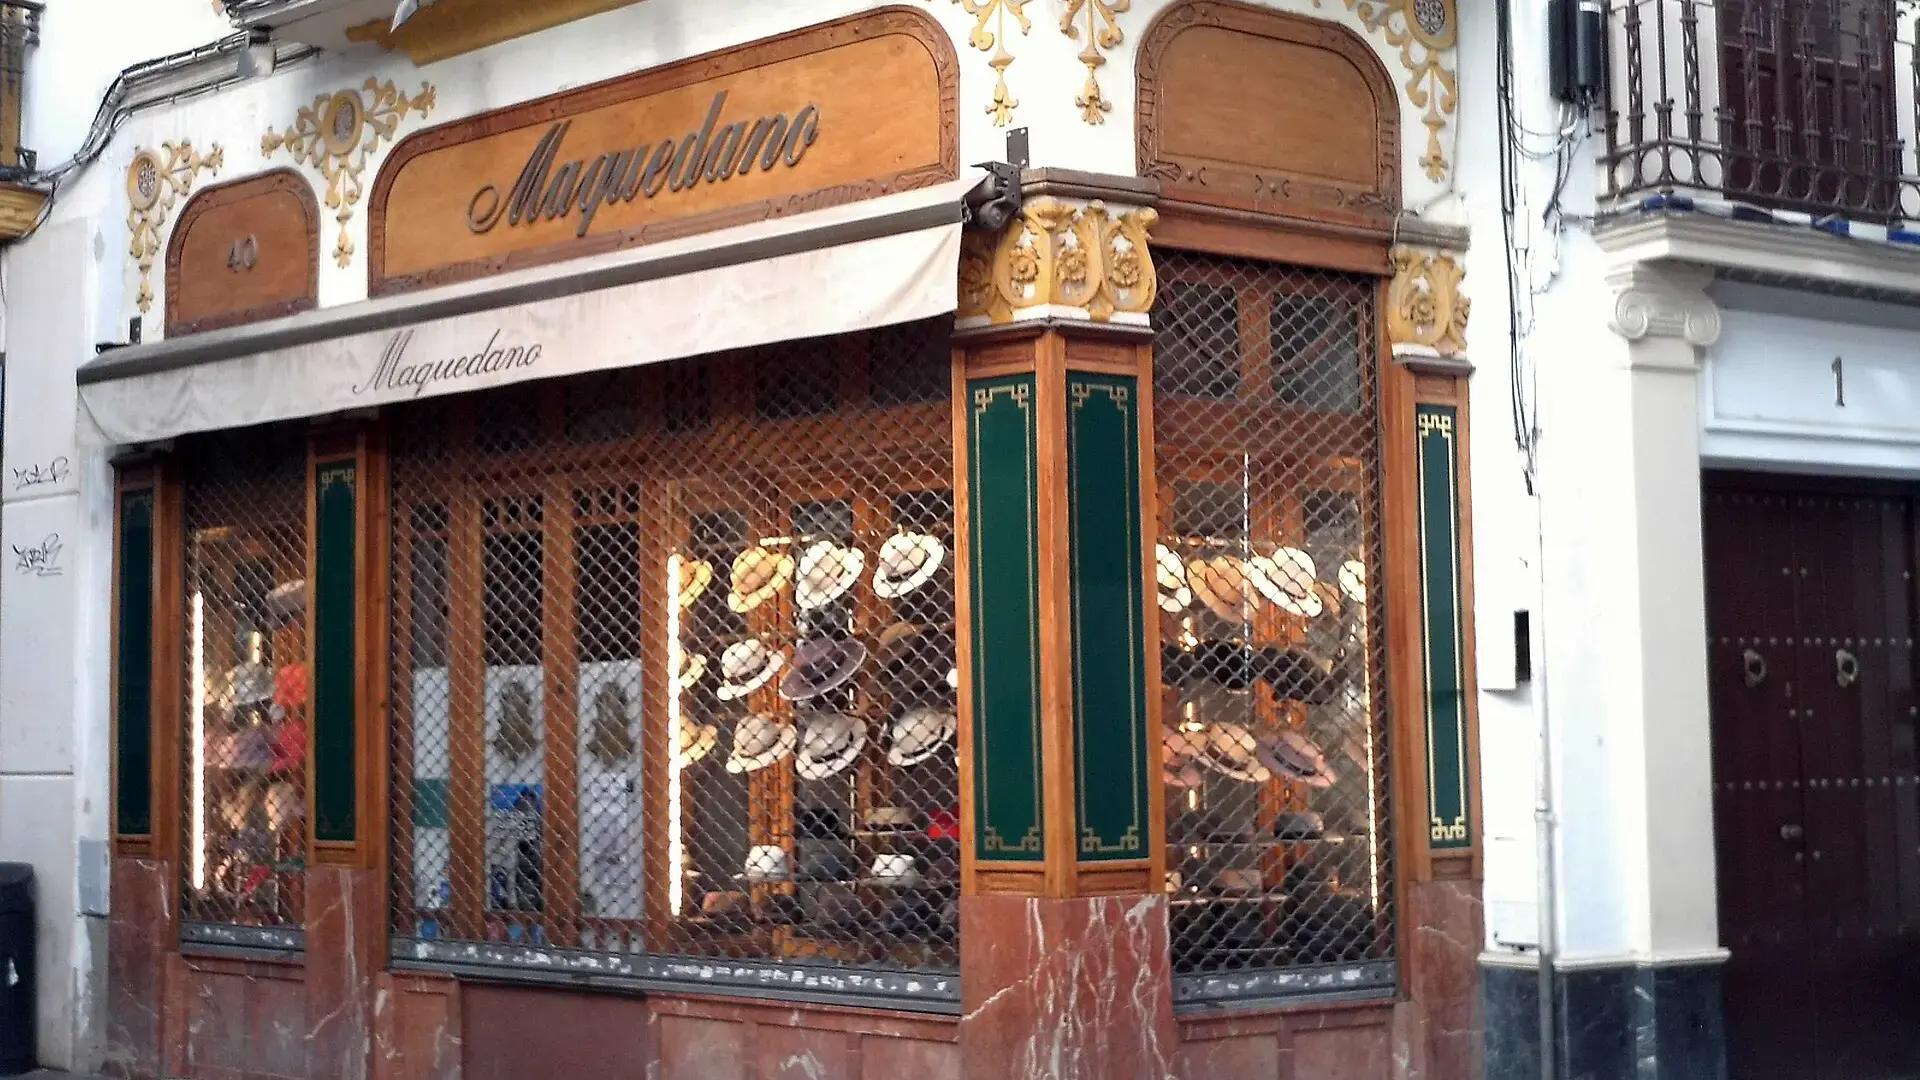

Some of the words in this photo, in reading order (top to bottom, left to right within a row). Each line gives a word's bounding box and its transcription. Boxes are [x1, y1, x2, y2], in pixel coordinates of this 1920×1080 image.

[466, 90, 820, 237] Maquedano
[226, 234, 258, 273] 40
[352, 328, 542, 398] Maquedano
[1831, 355, 1845, 407] 1
